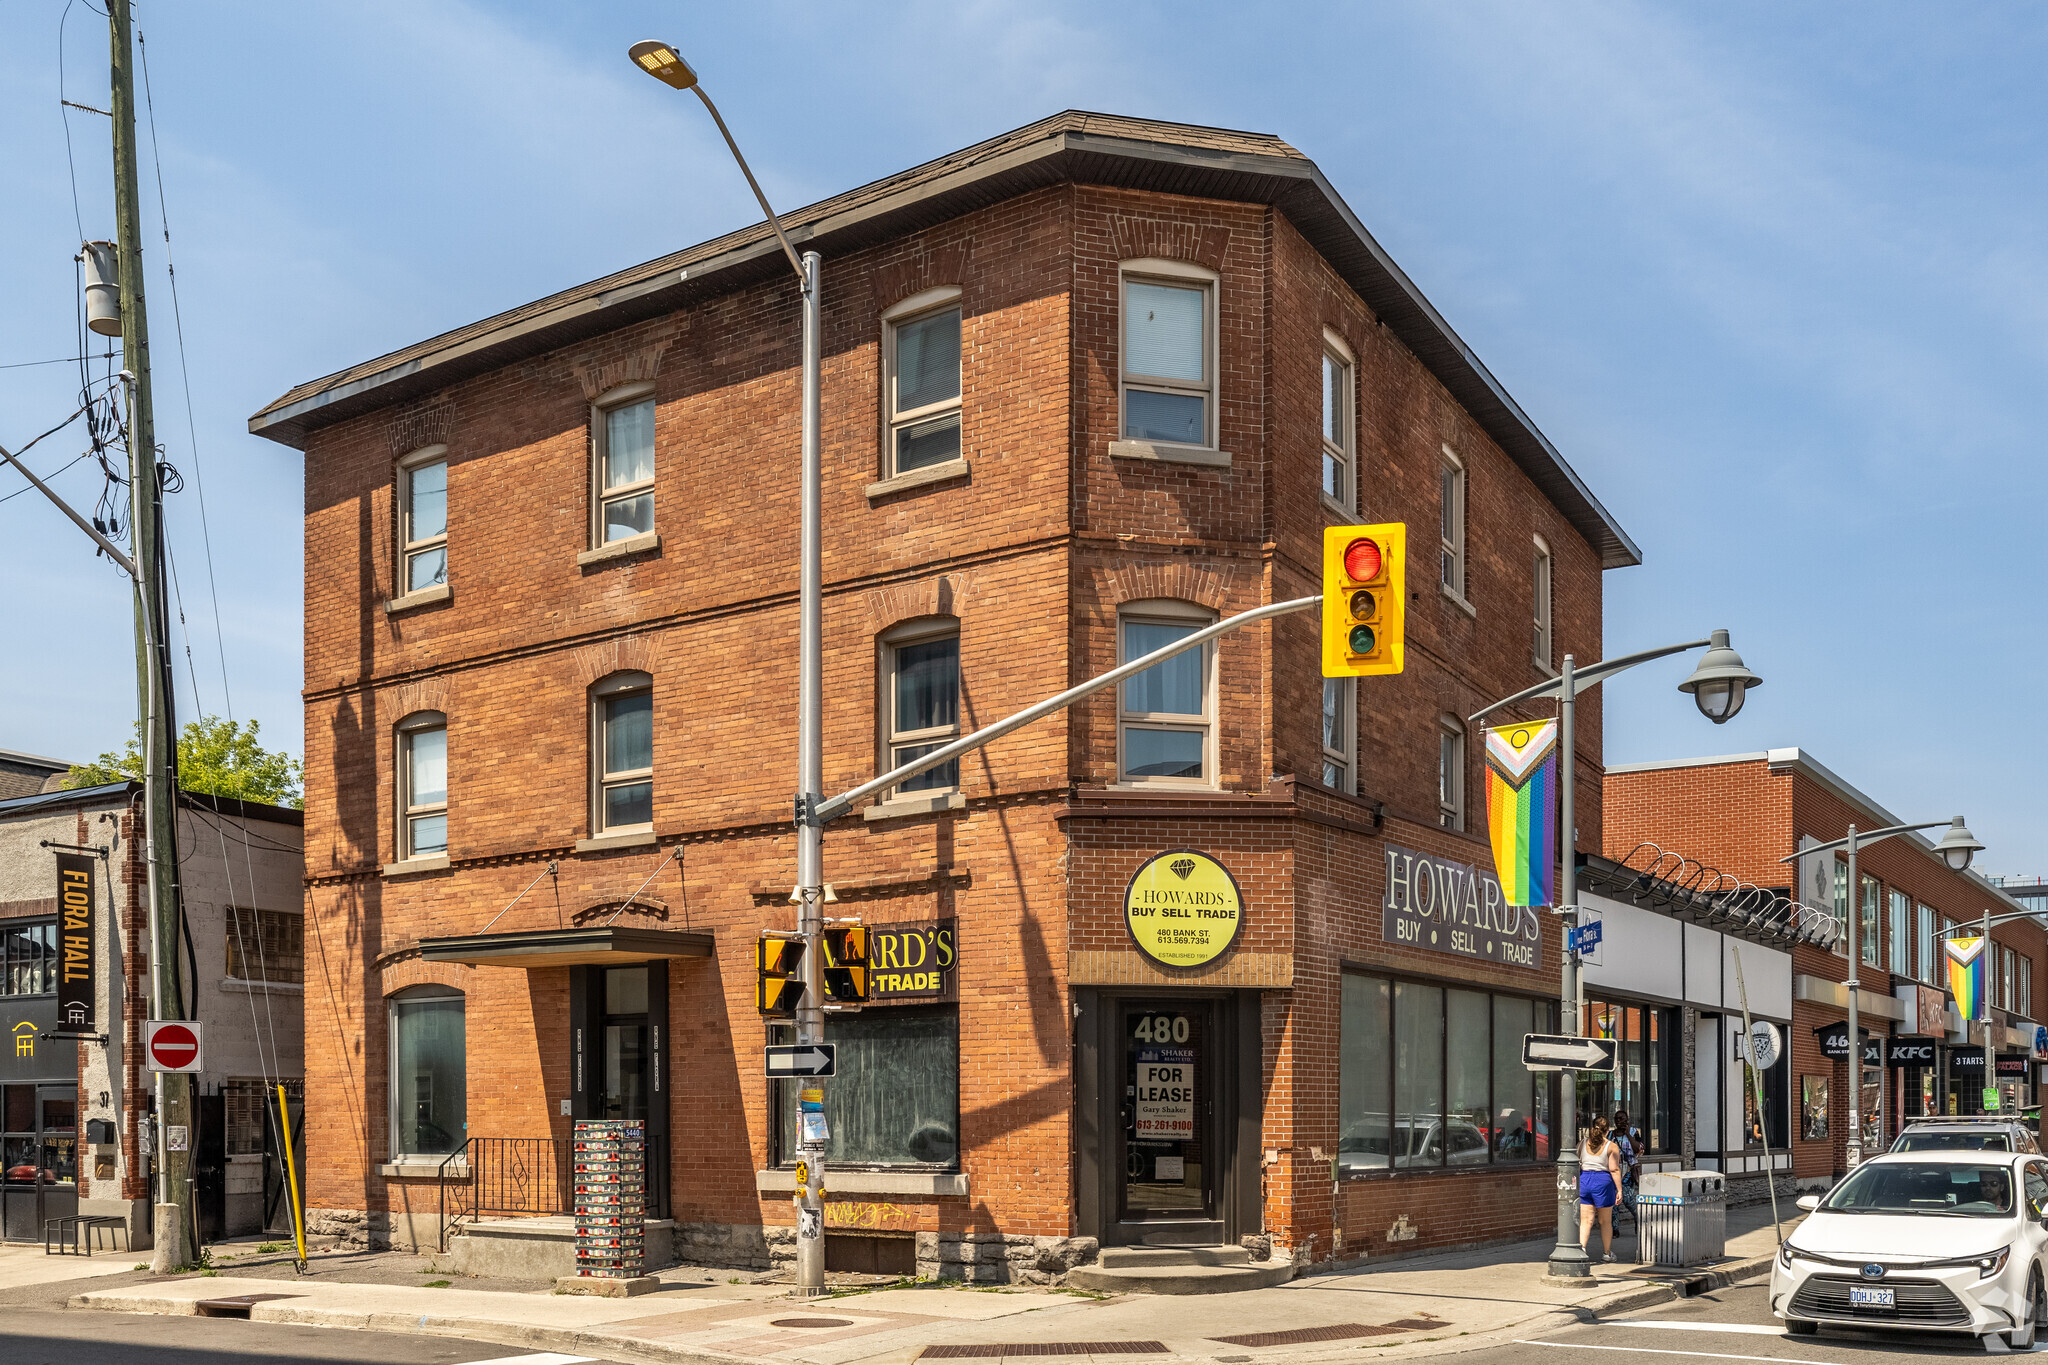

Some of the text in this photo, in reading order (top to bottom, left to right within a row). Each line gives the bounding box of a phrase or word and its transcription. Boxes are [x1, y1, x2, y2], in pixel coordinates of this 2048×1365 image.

[1143, 889, 1224, 906] HOWARDS
[1387, 850, 1539, 942] HOWARDS
[1131, 907, 1236, 919] BUY SELL TRADE
[63, 869, 89, 984] FLORA HALL
[1173, 929, 1197, 937] BANK
[1157, 936, 1210, 945] 613.569.7394
[1396, 917, 1533, 966] BUY SELL TRADE
[1583, 928, 1594, 943] Flora
[875, 971, 941, 992] TRADE
[1134, 1016, 1190, 1044] 480
[1825, 1035, 1859, 1048] 46
[1161, 1049, 1194, 1057] SHAKER
[1890, 1046, 1933, 1060] KFC
[1955, 1057, 1984, 1065] 3 TARTS
[1148, 1067, 1183, 1082] FOR
[99, 1090, 110, 1109] 37
[1138, 1087, 1192, 1102] LEASE
[1142, 1106, 1187, 1114] Gary Shaker
[1136, 1120, 1192, 1131] 613-261-9100
[1877, 1293, 1893, 1303] 327
